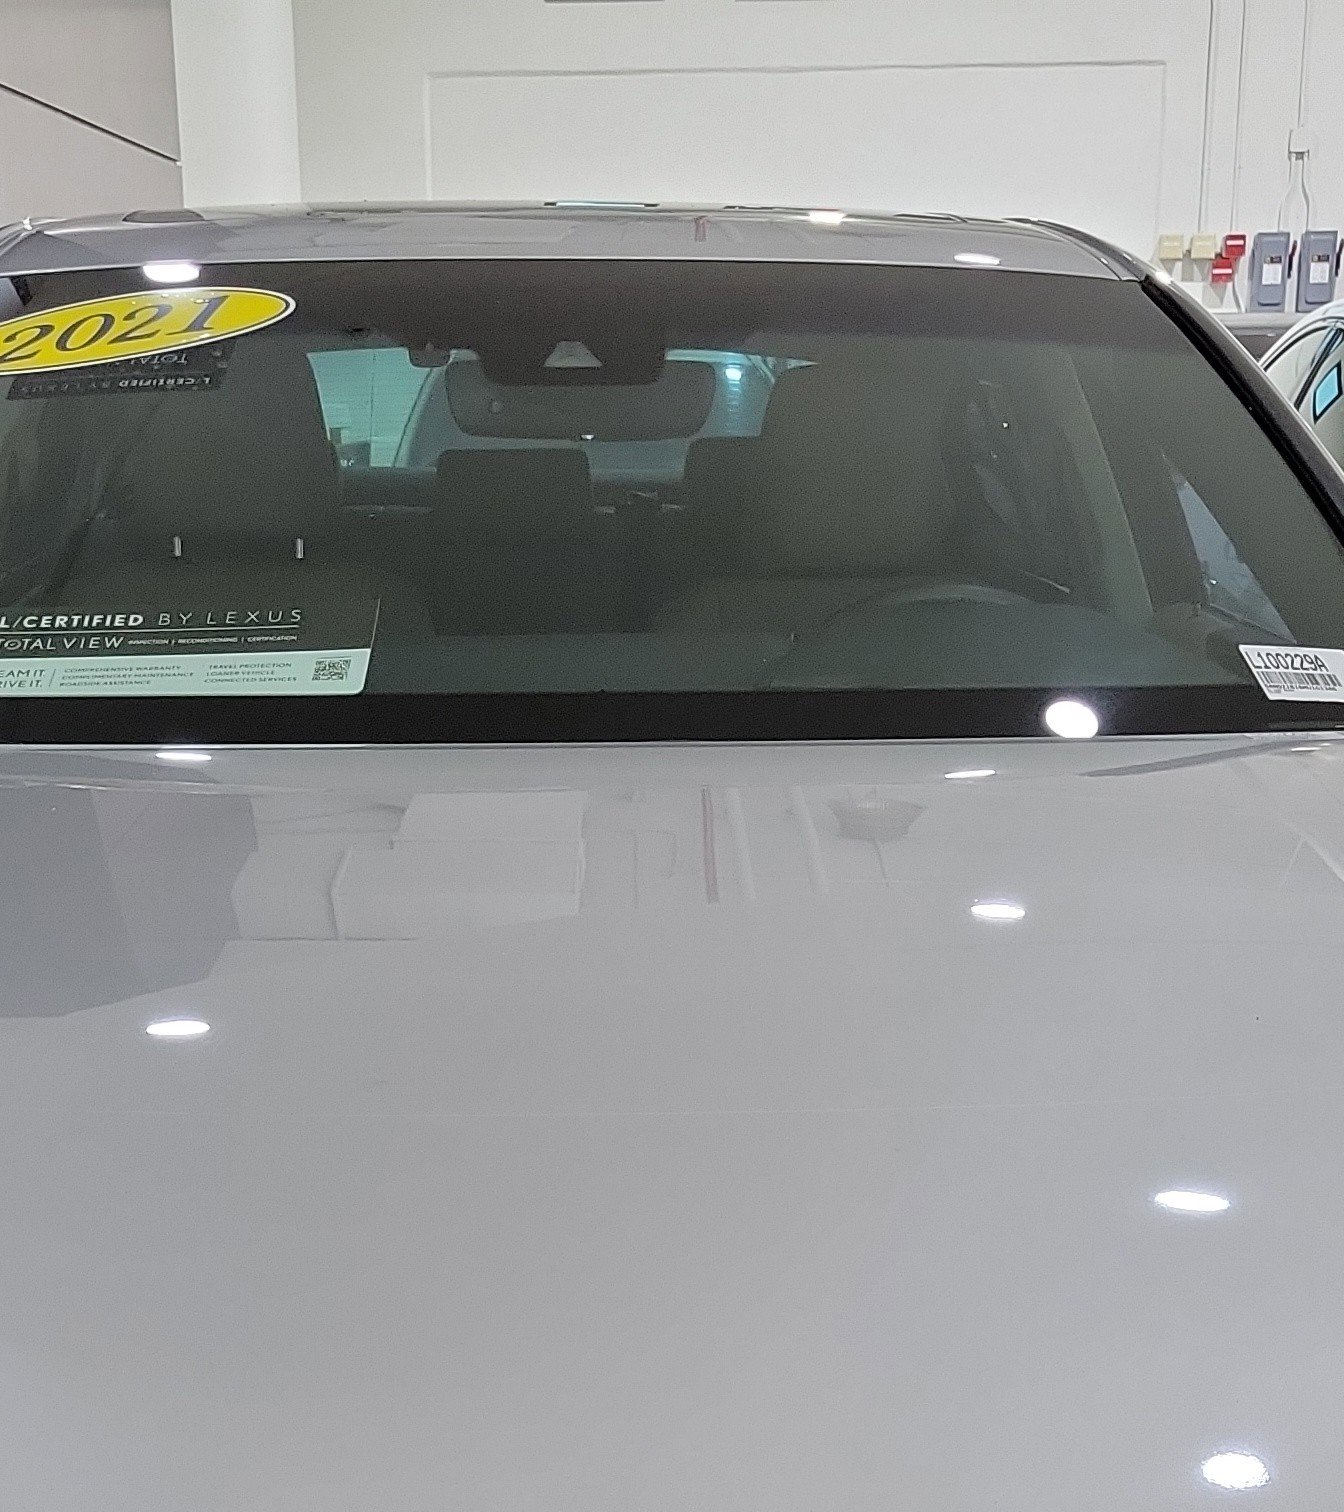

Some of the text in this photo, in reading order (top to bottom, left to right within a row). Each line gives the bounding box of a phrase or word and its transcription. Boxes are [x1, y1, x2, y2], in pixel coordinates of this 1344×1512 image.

[0, 609, 303, 629] L/CERTIFIED BY LEXUS
[63, 636, 125, 650] VIEW
[1244, 650, 1330, 673] L100229A
